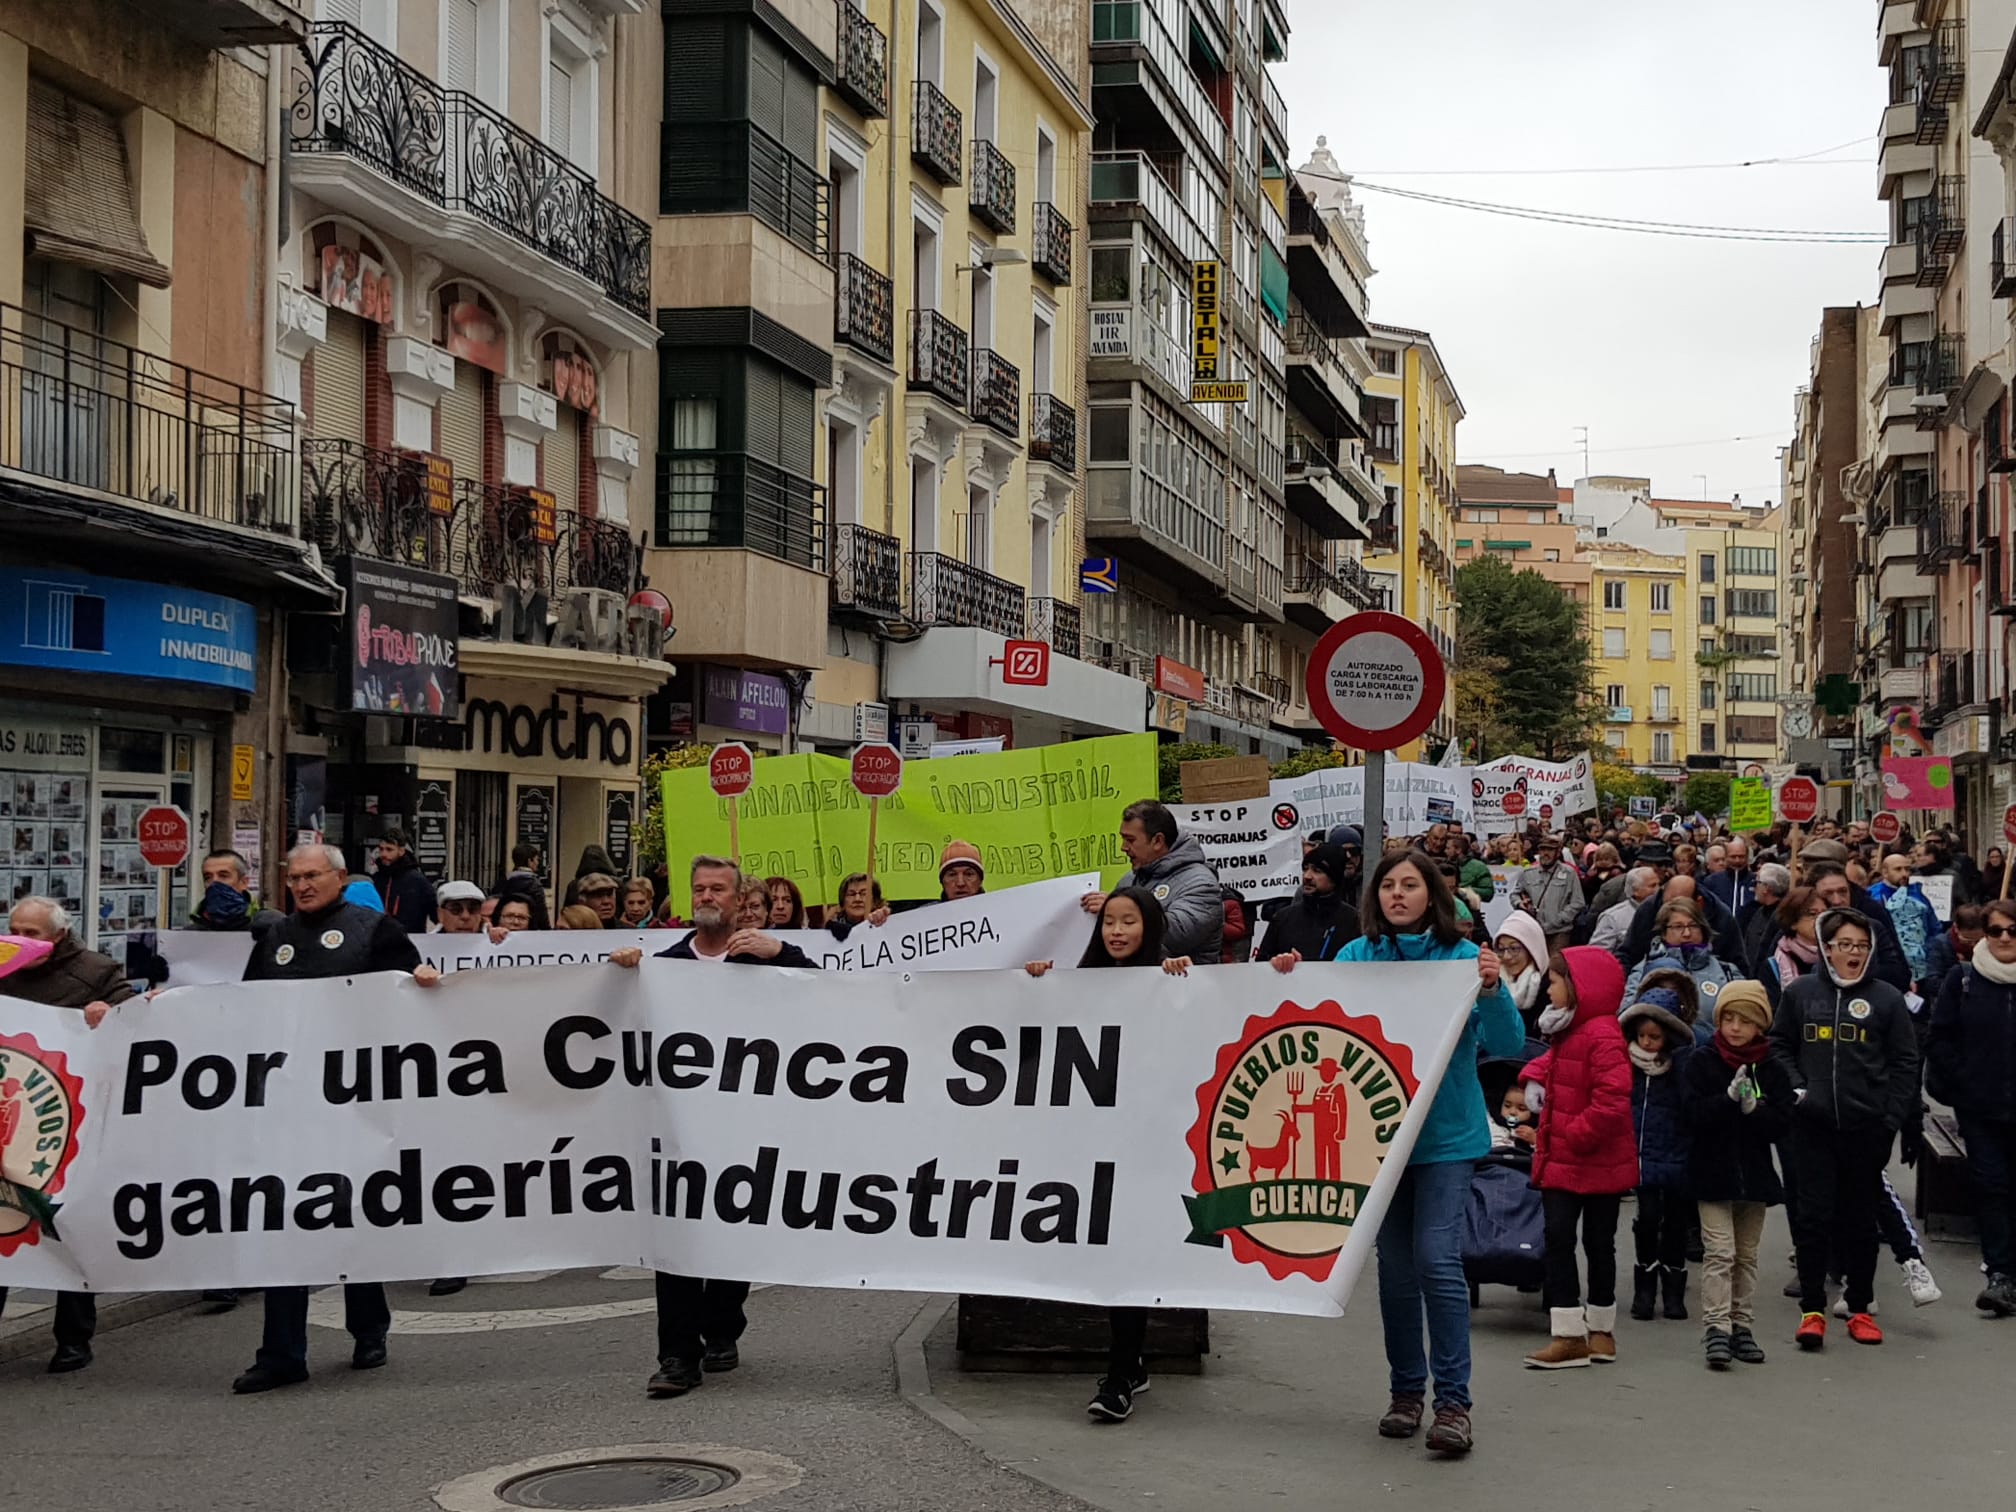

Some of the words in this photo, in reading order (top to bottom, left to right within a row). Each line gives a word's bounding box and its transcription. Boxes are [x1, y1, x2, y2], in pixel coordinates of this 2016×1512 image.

[1196, 264, 1216, 356] HOSTAL
[1095, 312, 1125, 324] HOSTAL
[1092, 341, 1128, 354] AVENIDA
[1193, 385, 1244, 399] AVENIDA
[162, 603, 229, 632] DUPLEX
[1347, 662, 1403, 672] AUTORIZADO
[1331, 670, 1361, 678] CARGA
[1371, 673, 1418, 682] DESCARGA
[1357, 681, 1414, 691] LABORABLES
[742, 681, 786, 708] AFFLELOU
[465, 690, 632, 767] martina
[715, 757, 743, 772] STOP
[859, 756, 892, 769] STOP
[1487, 786, 1511, 795] STOP
[1784, 788, 1811, 799] STOP
[1191, 807, 1247, 821] STOP
[145, 821, 178, 836] STOP
[1193, 829, 1268, 845] ROGRANJAS
[861, 941, 893, 968] LA
[901, 916, 1000, 961] SIERRA,
[122, 1039, 288, 1115] Por
[322, 1039, 507, 1104] una
[542, 1015, 907, 1103] Cuenca
[945, 1025, 1120, 1107] SIN
[1216, 1031, 1319, 1141] PUEBLOS
[1340, 1041, 1402, 1144] VIVOS
[23, 1068, 64, 1152] VIVOS
[112, 1136, 635, 1259] ganadería
[652, 1137, 1115, 1246] industrial
[1250, 1184, 1355, 1218] CUENCA
